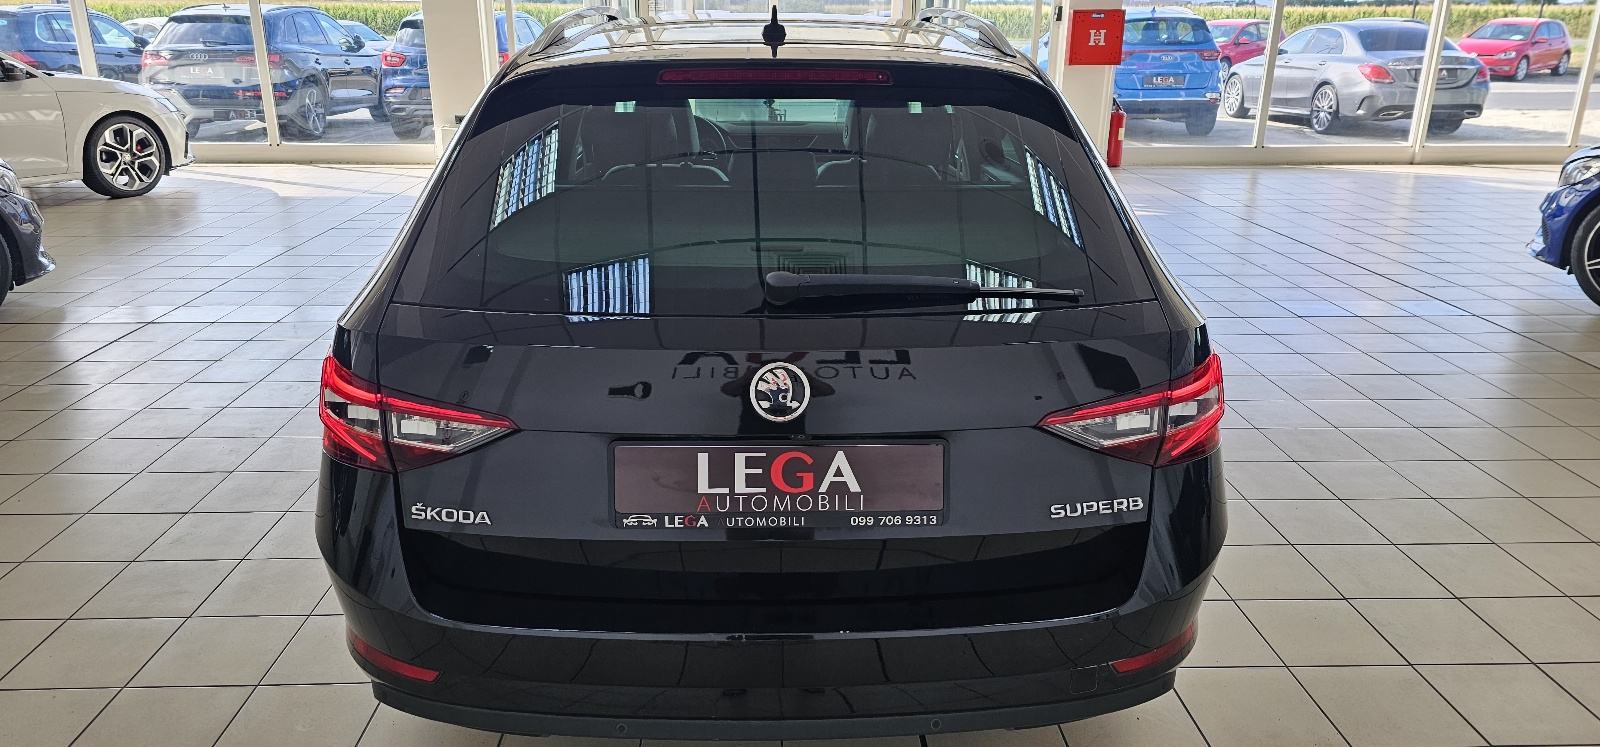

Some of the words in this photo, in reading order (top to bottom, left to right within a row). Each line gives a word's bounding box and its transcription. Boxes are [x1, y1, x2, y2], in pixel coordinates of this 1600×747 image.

[1088, 29, 1106, 46] H
[697, 451, 862, 494] LEGA
[696, 494, 864, 512] AUTOMOBILI
[1050, 497, 1144, 519] SUPERB
[411, 502, 492, 525] ŠKODA
[664, 515, 709, 528] LEGA
[850, 516, 874, 526] 099
[879, 516, 902, 526] 706
[905, 515, 937, 525] 9313
